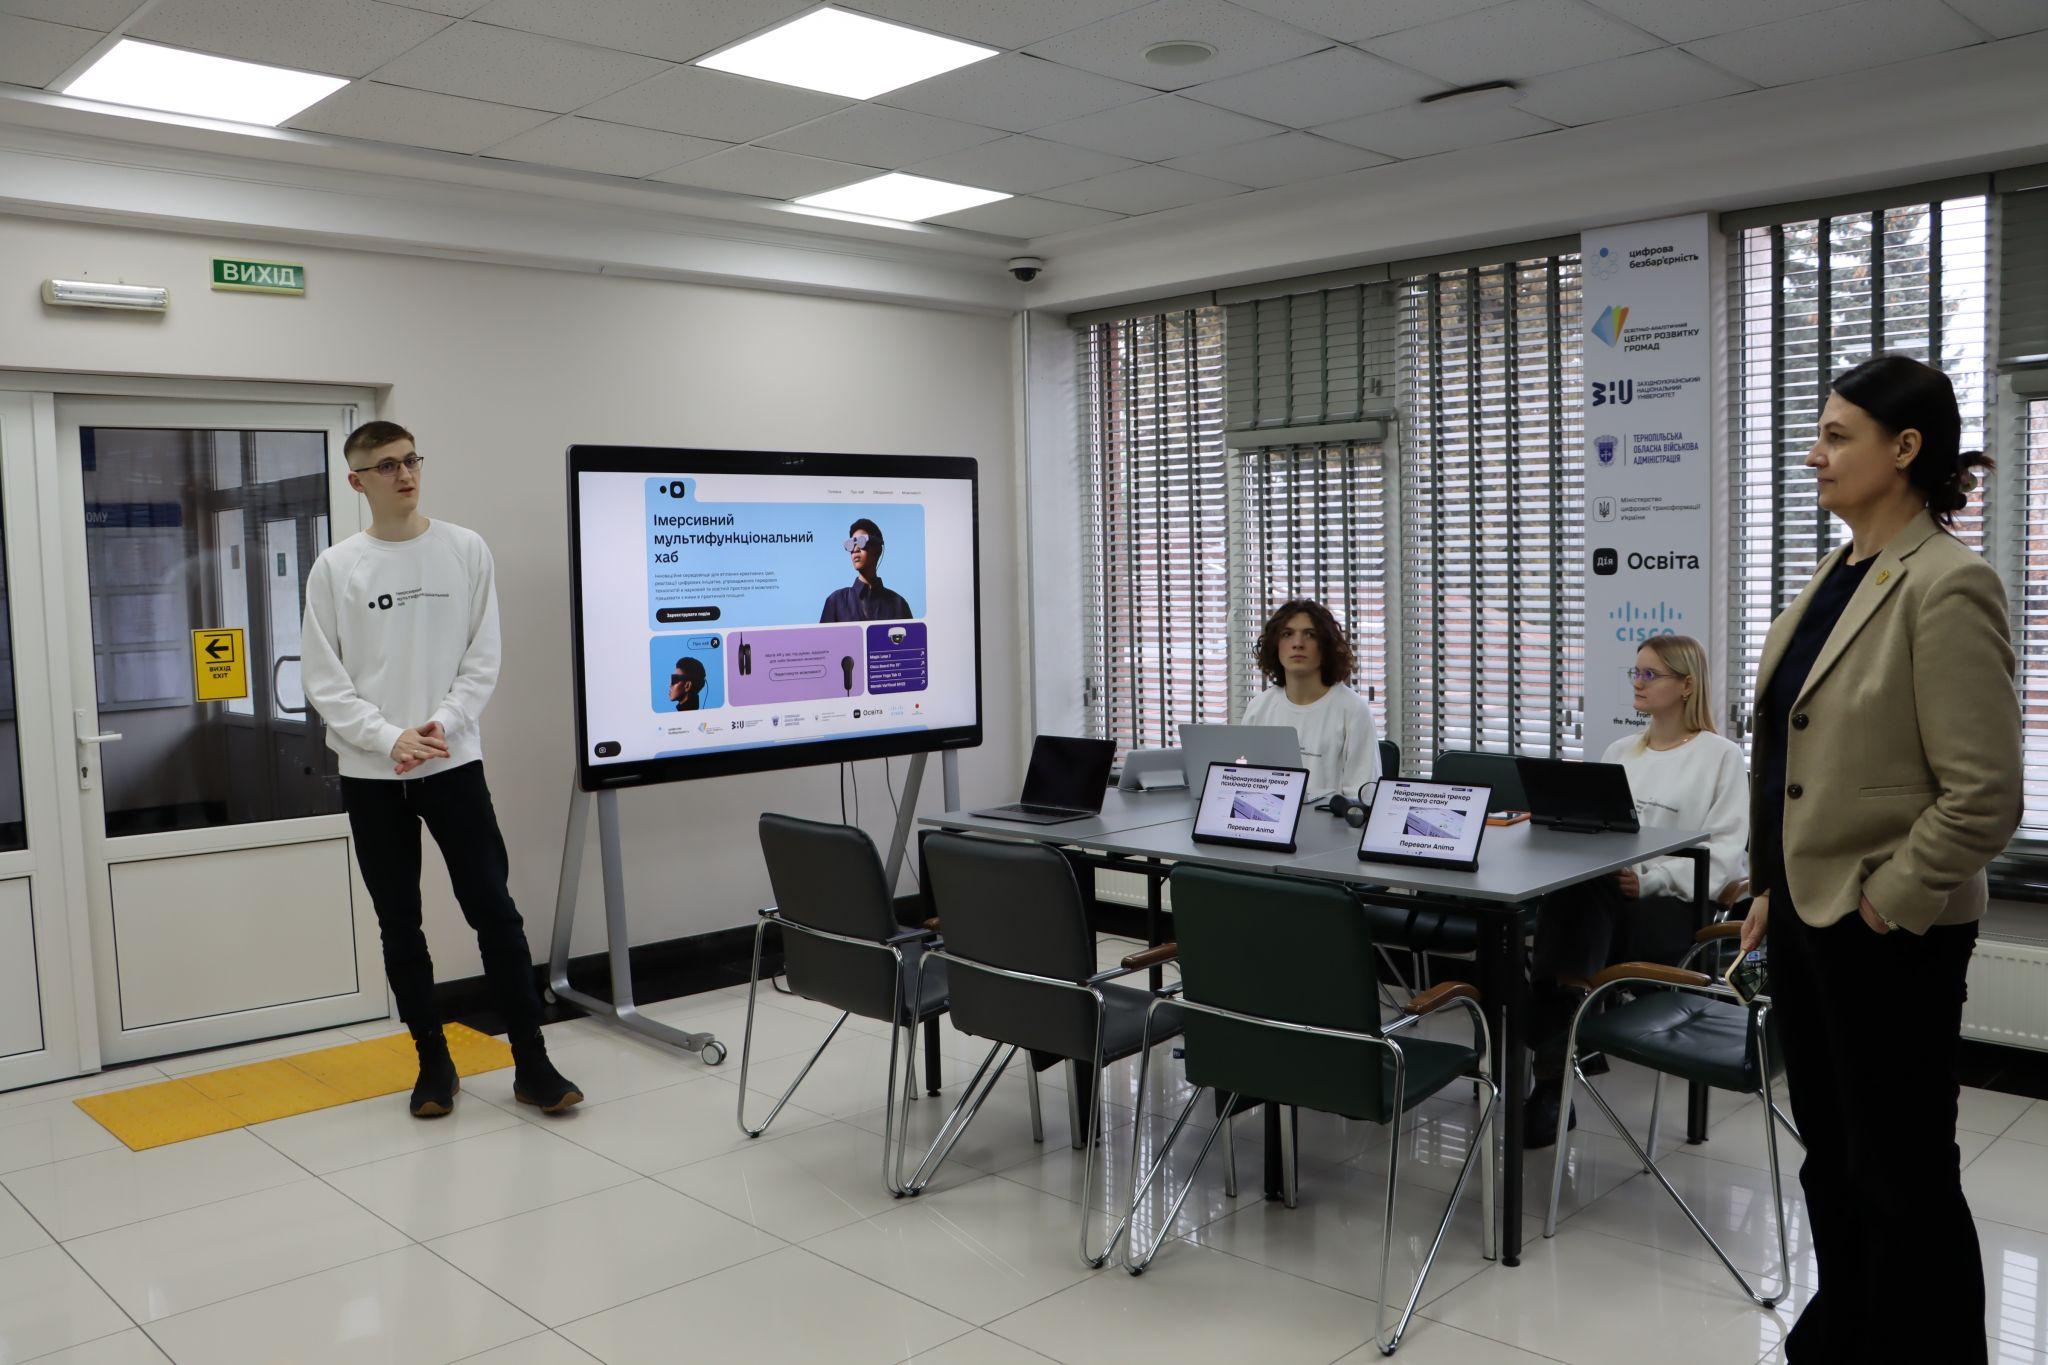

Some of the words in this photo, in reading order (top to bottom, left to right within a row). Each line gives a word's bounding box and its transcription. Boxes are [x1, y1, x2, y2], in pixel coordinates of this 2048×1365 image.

[1629, 245, 1674, 258] цифрова
[223, 262, 296, 287] ВИХІД
[1624, 333, 1652, 343] ЦЕНТР
[1654, 328, 1700, 340] РОЗВИТКУ
[1624, 342, 1660, 352] ГРОМАД
[1633, 432, 1683, 442] ТЕРНОПІЛЬСЬКА
[1633, 444, 1662, 453] ОБЛАСНА
[1663, 442, 1699, 451] ВІЙСЬКОВА
[1633, 454, 1681, 464] АДМІНІСТРАЦІЯ
[653, 513, 735, 529] Імерсивний
[654, 531, 814, 548] мультифункціональний
[654, 551, 679, 563] хаб
[1597, 556, 1614, 567] Дія
[1627, 551, 1700, 570] Освіта
[1613, 717, 1623, 725] the
[1625, 718, 1647, 726] People
[1392, 796, 1428, 804] психічного
[1393, 789, 1446, 800] Нейронауковий
[1447, 793, 1471, 801] трекер
[1399, 840, 1432, 849] Переваги
